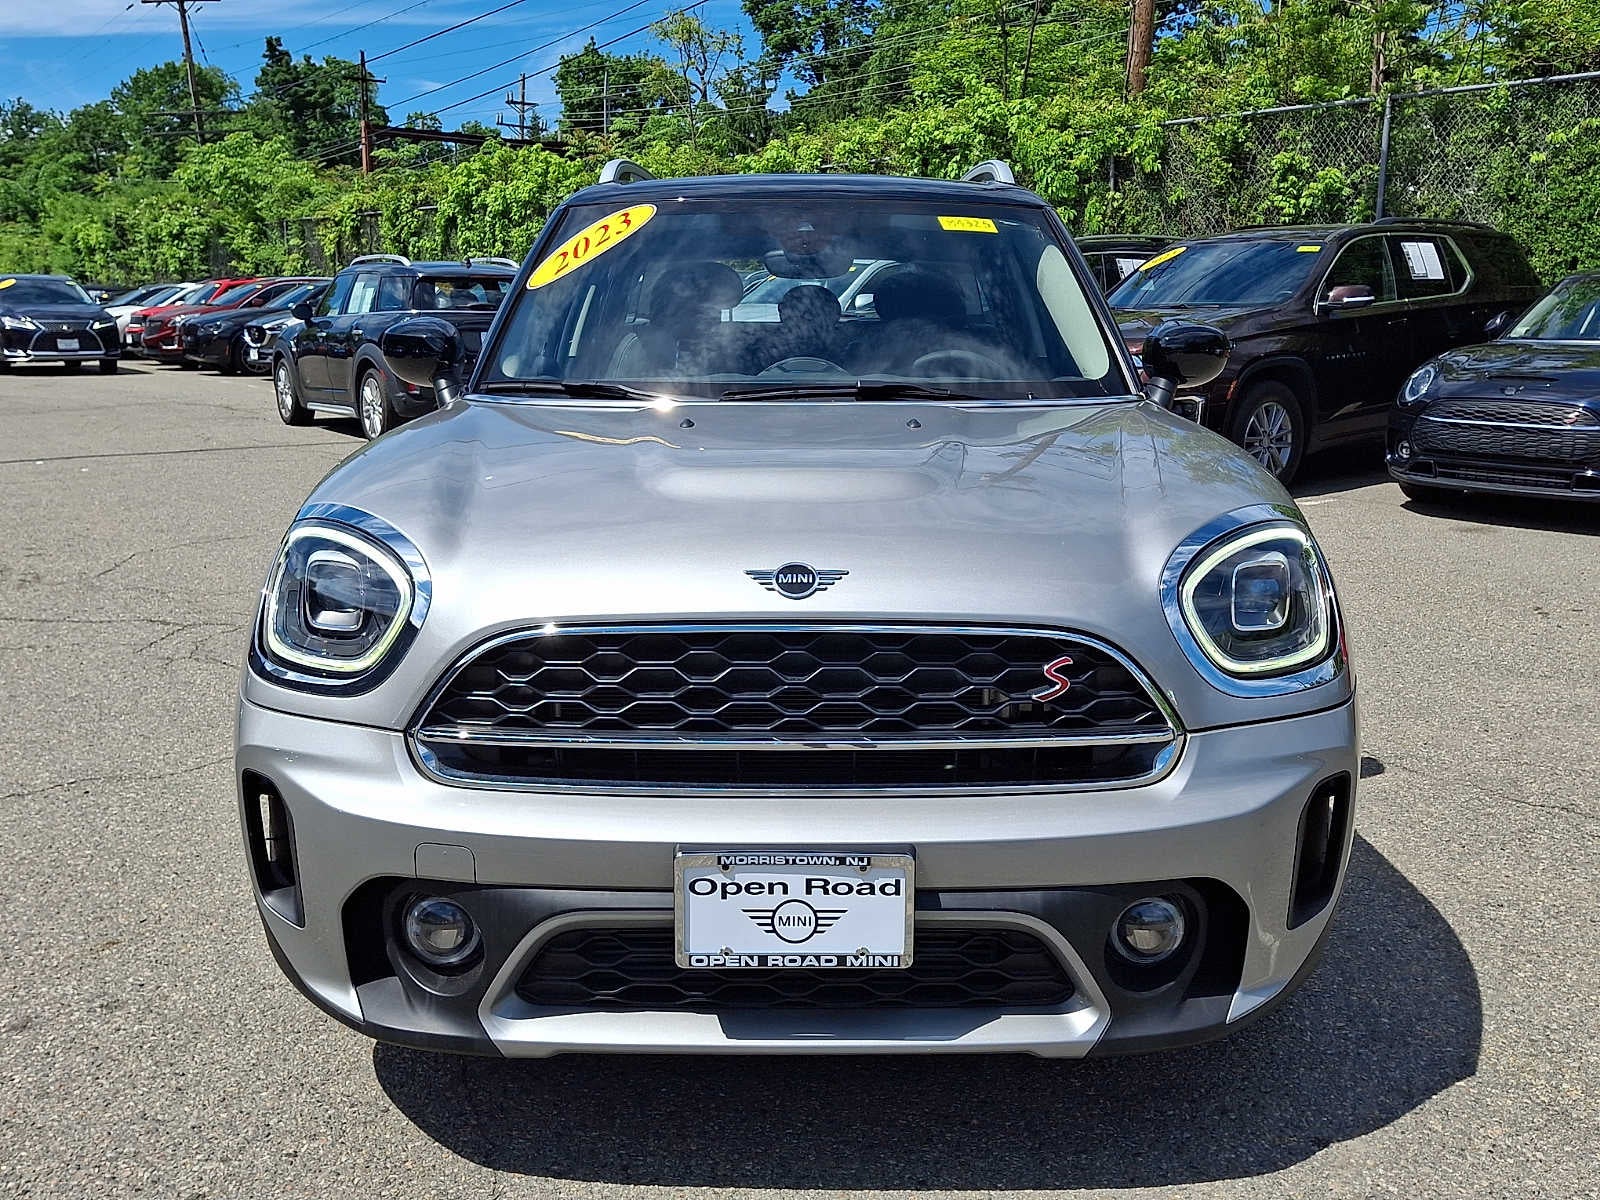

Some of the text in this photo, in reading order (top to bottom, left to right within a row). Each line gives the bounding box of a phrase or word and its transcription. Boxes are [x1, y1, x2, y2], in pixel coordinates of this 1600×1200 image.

[553, 212, 632, 275] 2023
[778, 573, 813, 583] MINI
[1031, 656, 1074, 702] S
[720, 855, 868, 866] MORRISTOWN, NJ
[688, 877, 901, 899] Open Road
[778, 915, 812, 927] MINI
[690, 955, 899, 967] OPEN ROAD MINI
